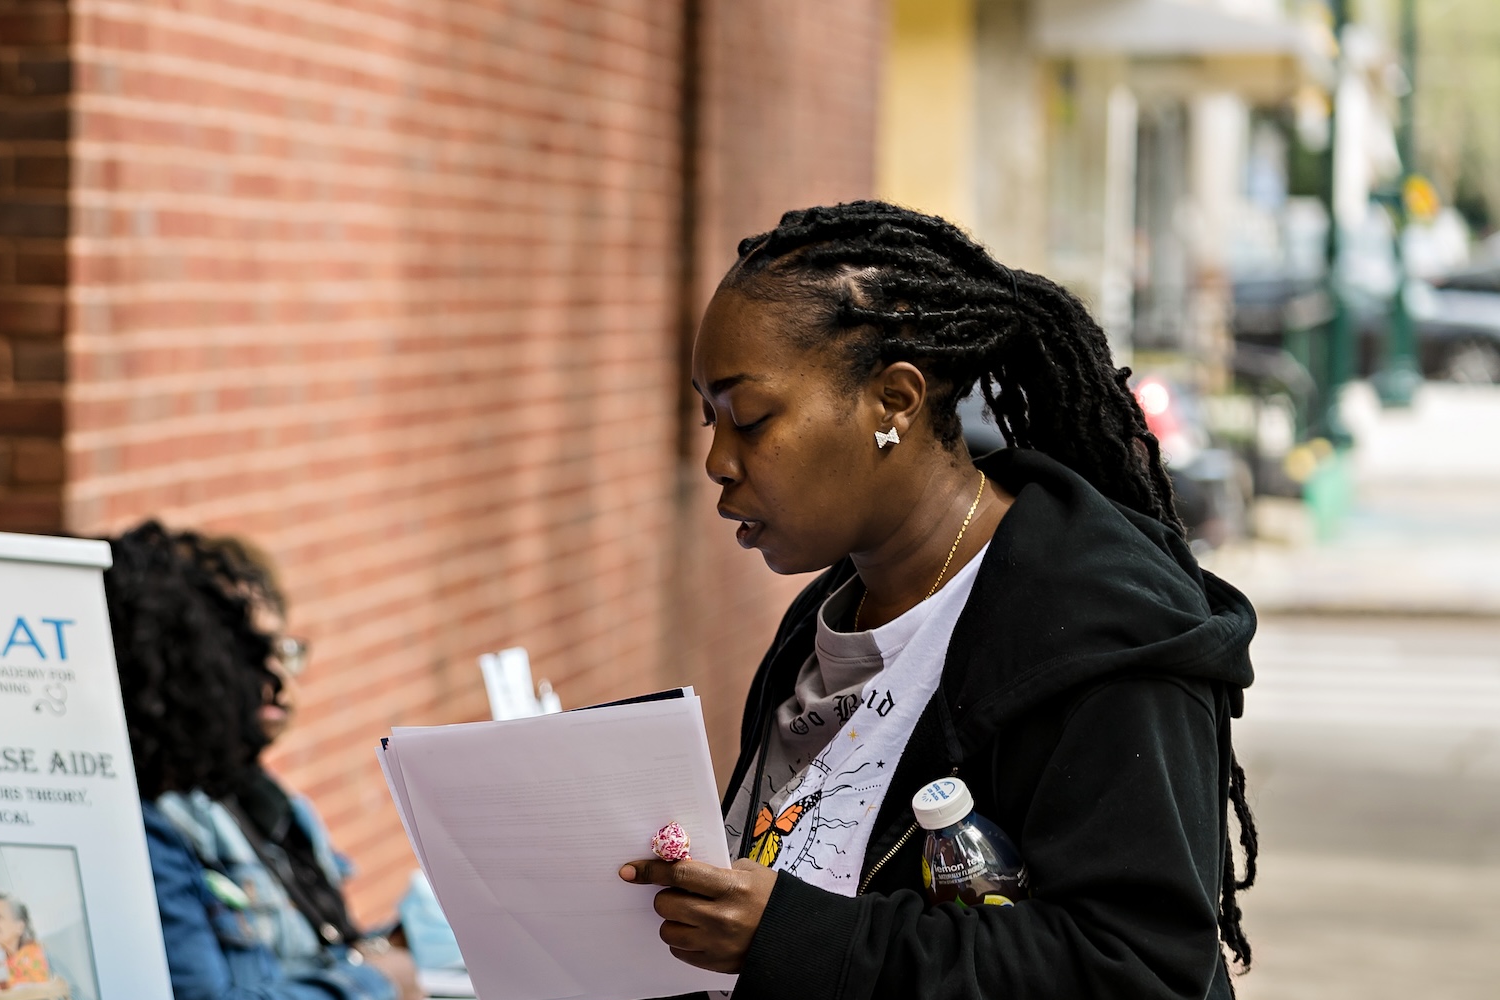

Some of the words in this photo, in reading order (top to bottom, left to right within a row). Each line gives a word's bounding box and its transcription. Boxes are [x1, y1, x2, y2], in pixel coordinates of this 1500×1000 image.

[50, 668, 76, 682] FOR
[789, 711, 825, 735] Go
[832, 689, 896, 726] Bld
[48, 750, 118, 779] AIDE
[934, 861, 964, 874] lemon
